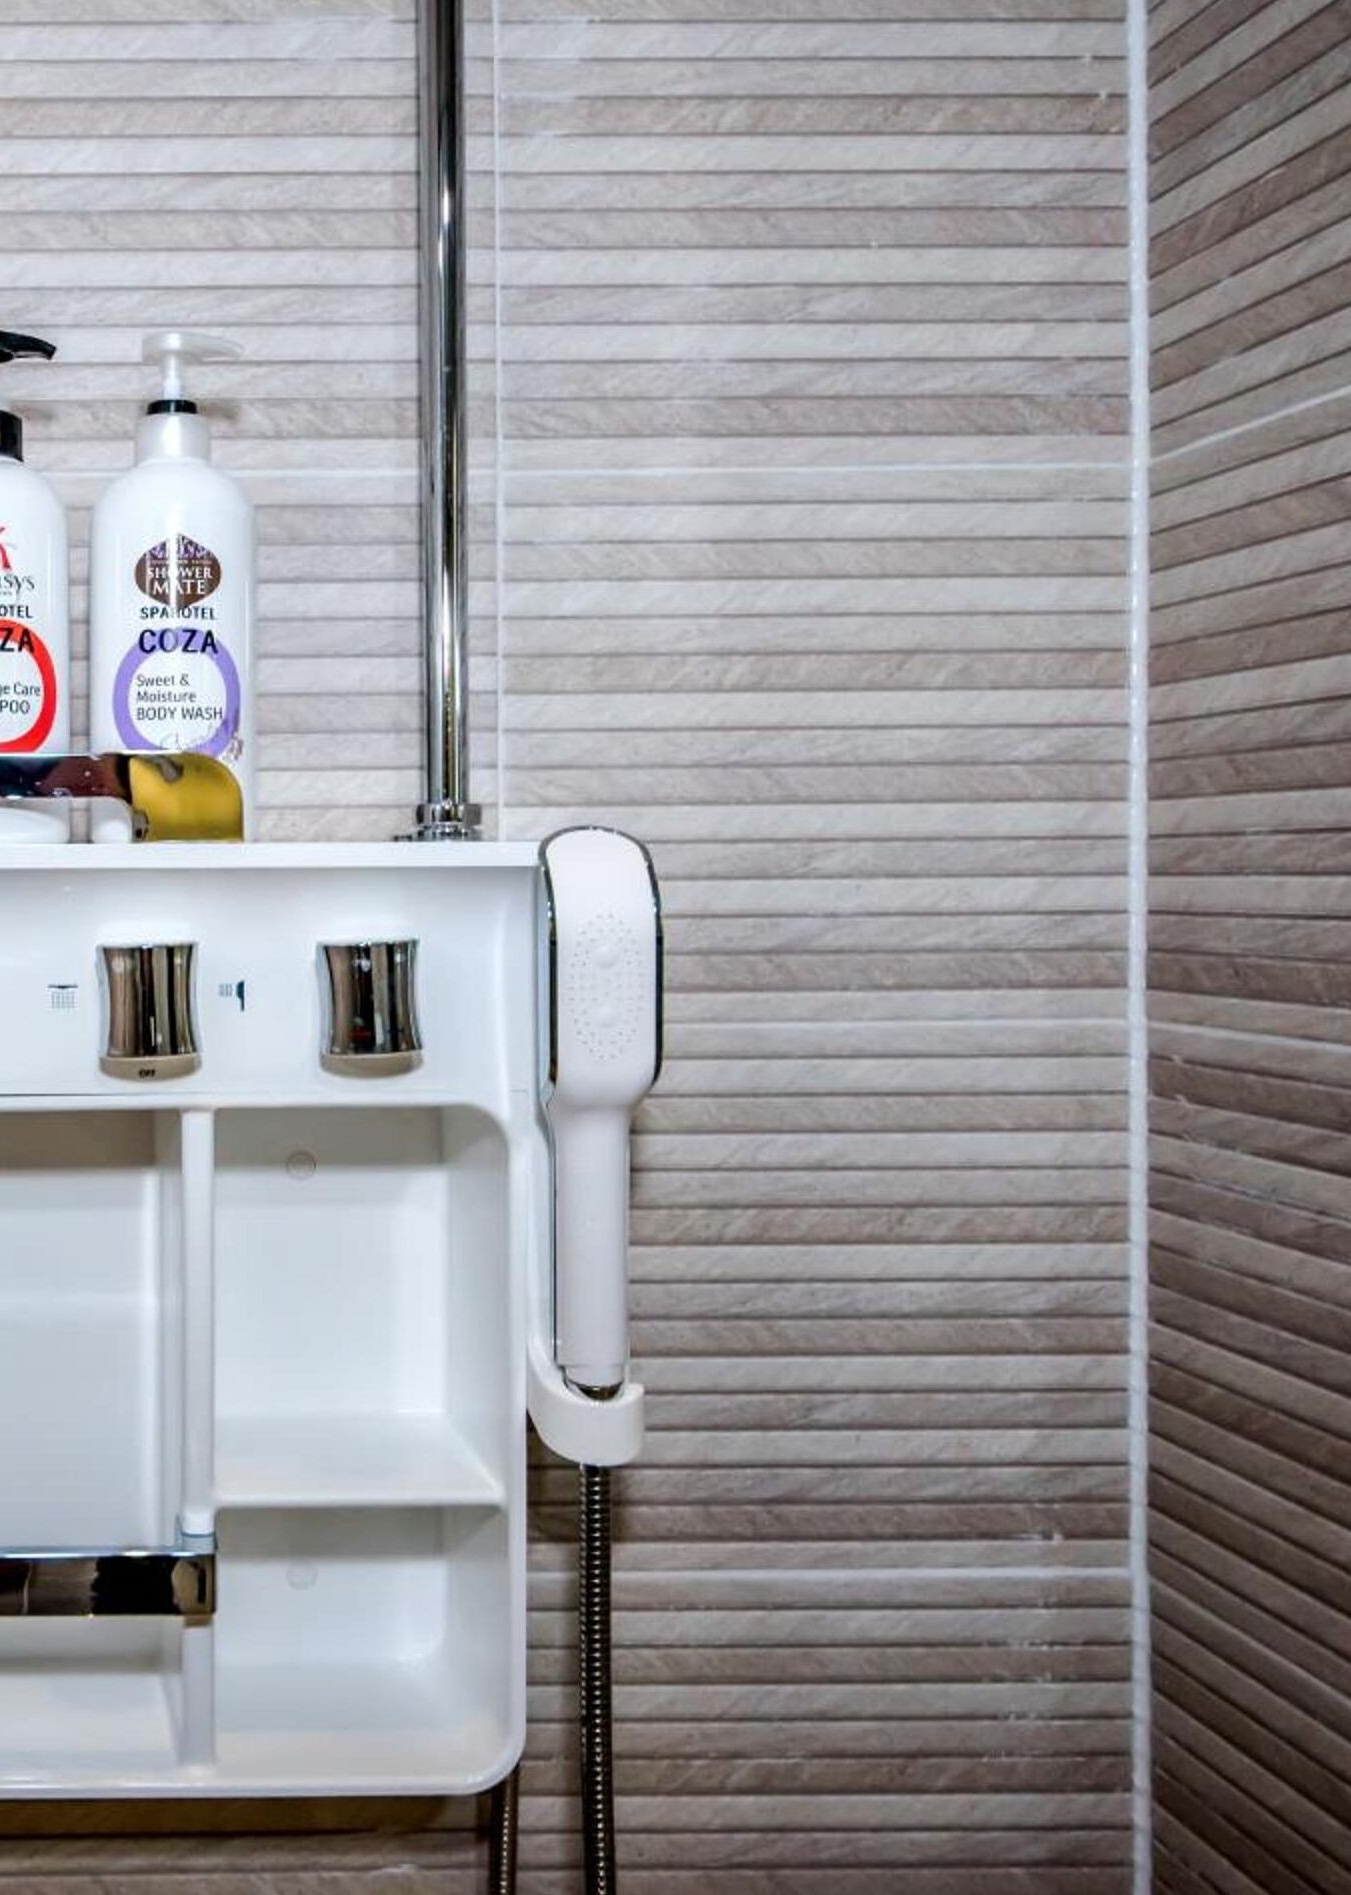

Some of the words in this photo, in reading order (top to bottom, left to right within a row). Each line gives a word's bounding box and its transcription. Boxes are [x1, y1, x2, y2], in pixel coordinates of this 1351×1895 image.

[147, 566, 213, 579] SHWER
[139, 628, 218, 654] COZA
[136, 674, 176, 687] Sweet
[179, 674, 190, 687] &
[13, 683, 41, 697] Care
[136, 691, 197, 703] Moisture
[136, 707, 177, 721] BODY
[181, 706, 223, 720] WASH
